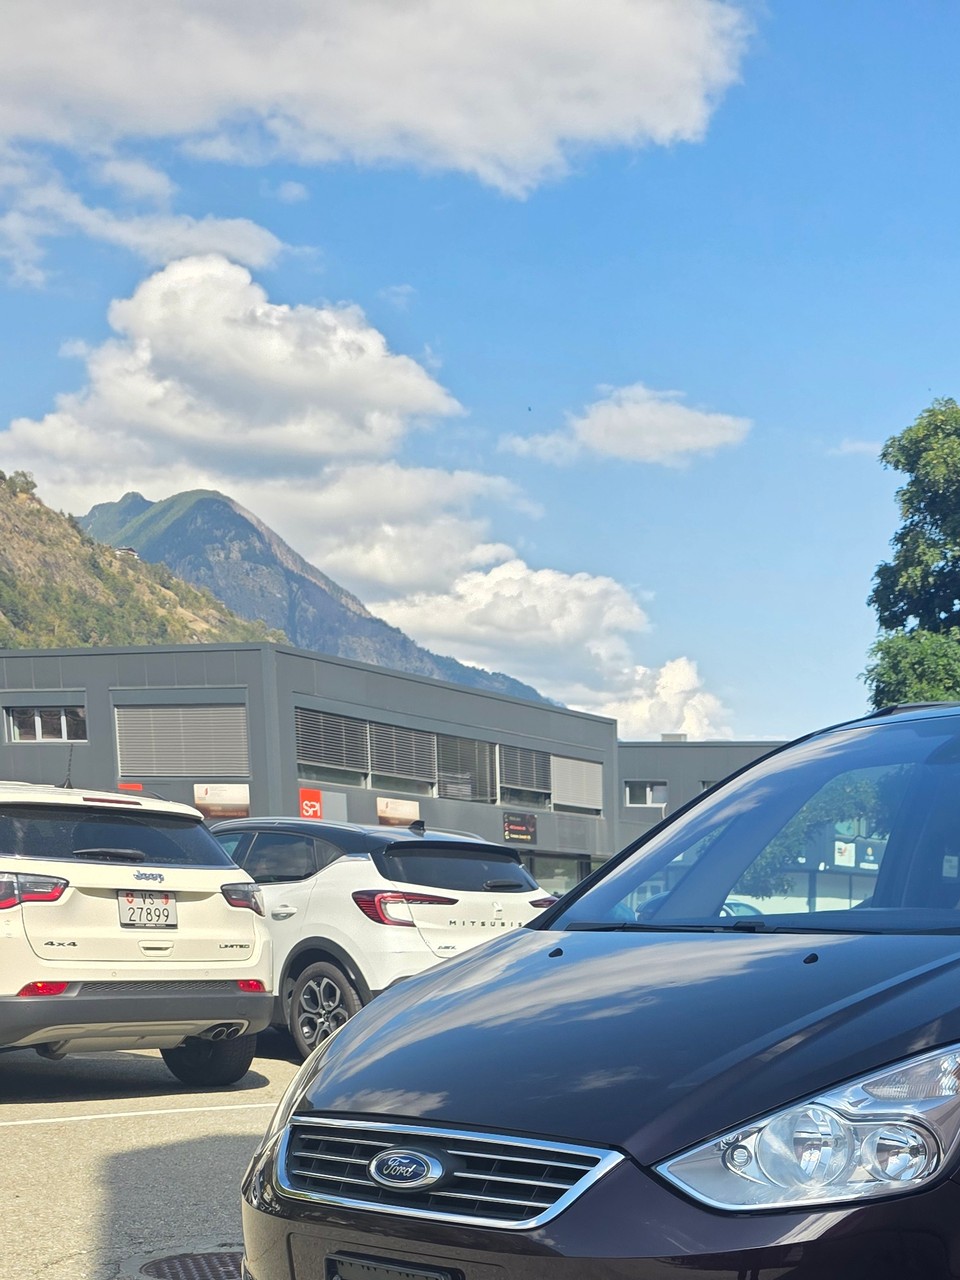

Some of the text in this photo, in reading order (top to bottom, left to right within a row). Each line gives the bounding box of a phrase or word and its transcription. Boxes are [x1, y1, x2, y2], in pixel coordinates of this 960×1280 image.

[302, 800, 321, 816] SPI
[133, 870, 165, 884] Jeep
[141, 893, 155, 905] VS
[127, 907, 170, 923] 27899
[449, 920, 523, 928] MITSUBIS
[382, 1157, 418, 1177] Ford
